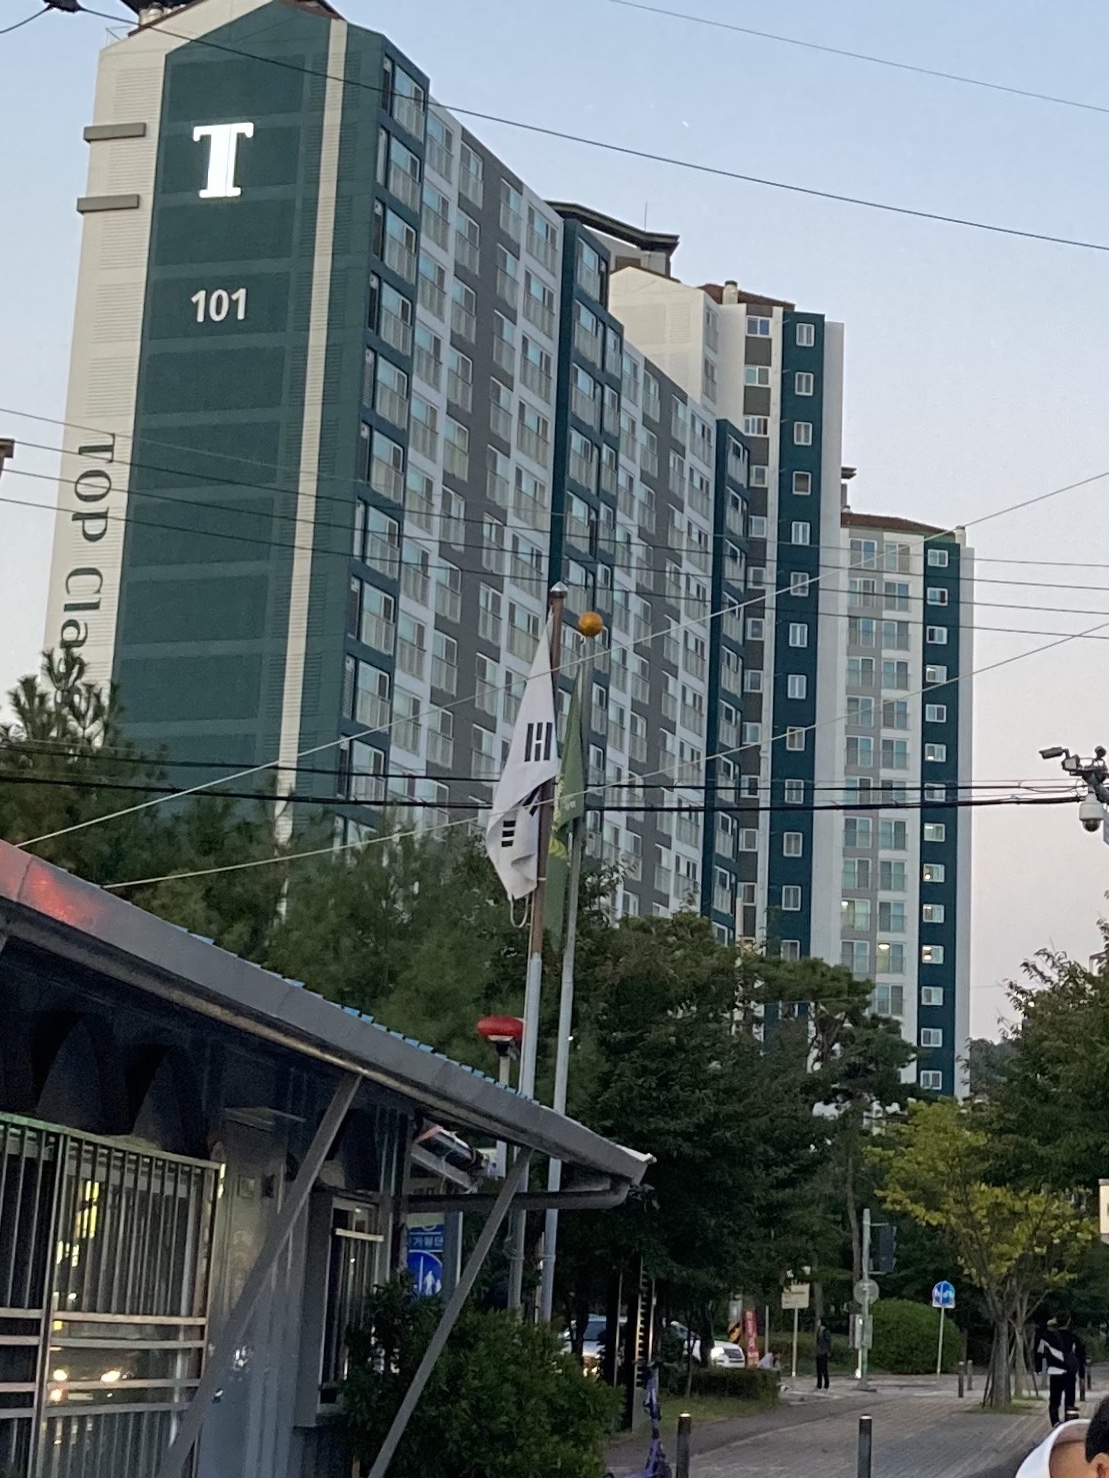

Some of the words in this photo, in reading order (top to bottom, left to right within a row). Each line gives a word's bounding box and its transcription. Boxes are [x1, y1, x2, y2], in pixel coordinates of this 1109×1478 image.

[193, 122, 254, 198] T
[191, 288, 247, 323] 101
[72, 433, 116, 542] TOP
